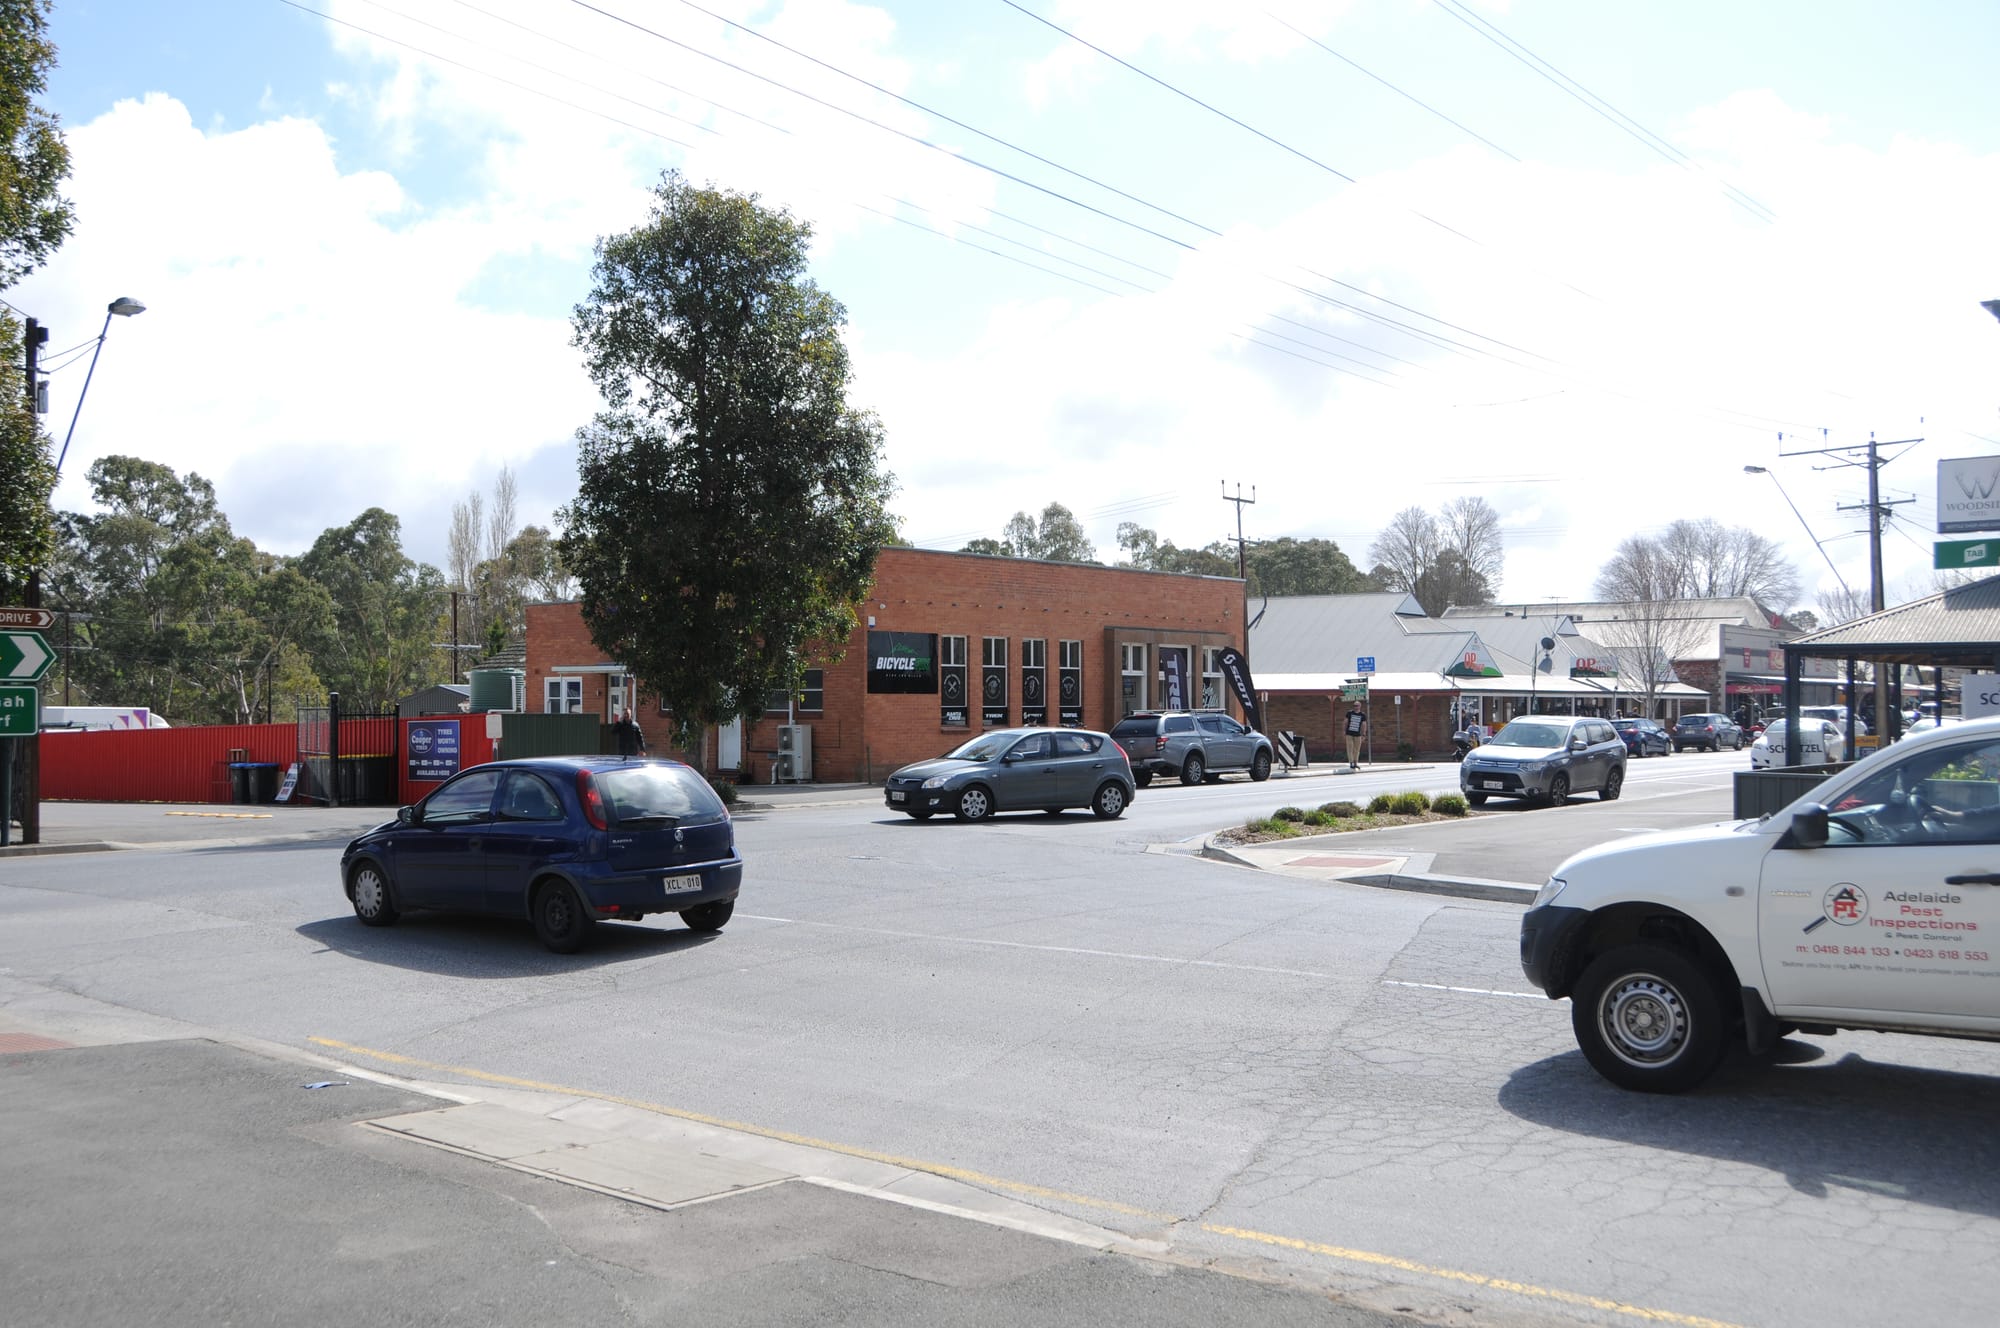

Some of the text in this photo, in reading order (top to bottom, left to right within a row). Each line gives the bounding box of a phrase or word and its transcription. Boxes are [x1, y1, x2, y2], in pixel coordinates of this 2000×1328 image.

[1946, 500, 2000, 511] WOODSI
[0, 612, 32, 623] DRIVE
[876, 657, 915, 670] BICYCLE
[1230, 665, 1253, 709] SCOTT
[411, 735, 432, 745] Cooper
[1884, 891, 1962, 904] Adelaide
[1900, 905, 1944, 917] Pest
[1869, 917, 1978, 930] Inspections
[1812, 945, 1840, 954] 0418
[1871, 947, 1891, 957] 133
[1903, 948, 1934, 959] 0423
[1964, 951, 1989, 961] 553
